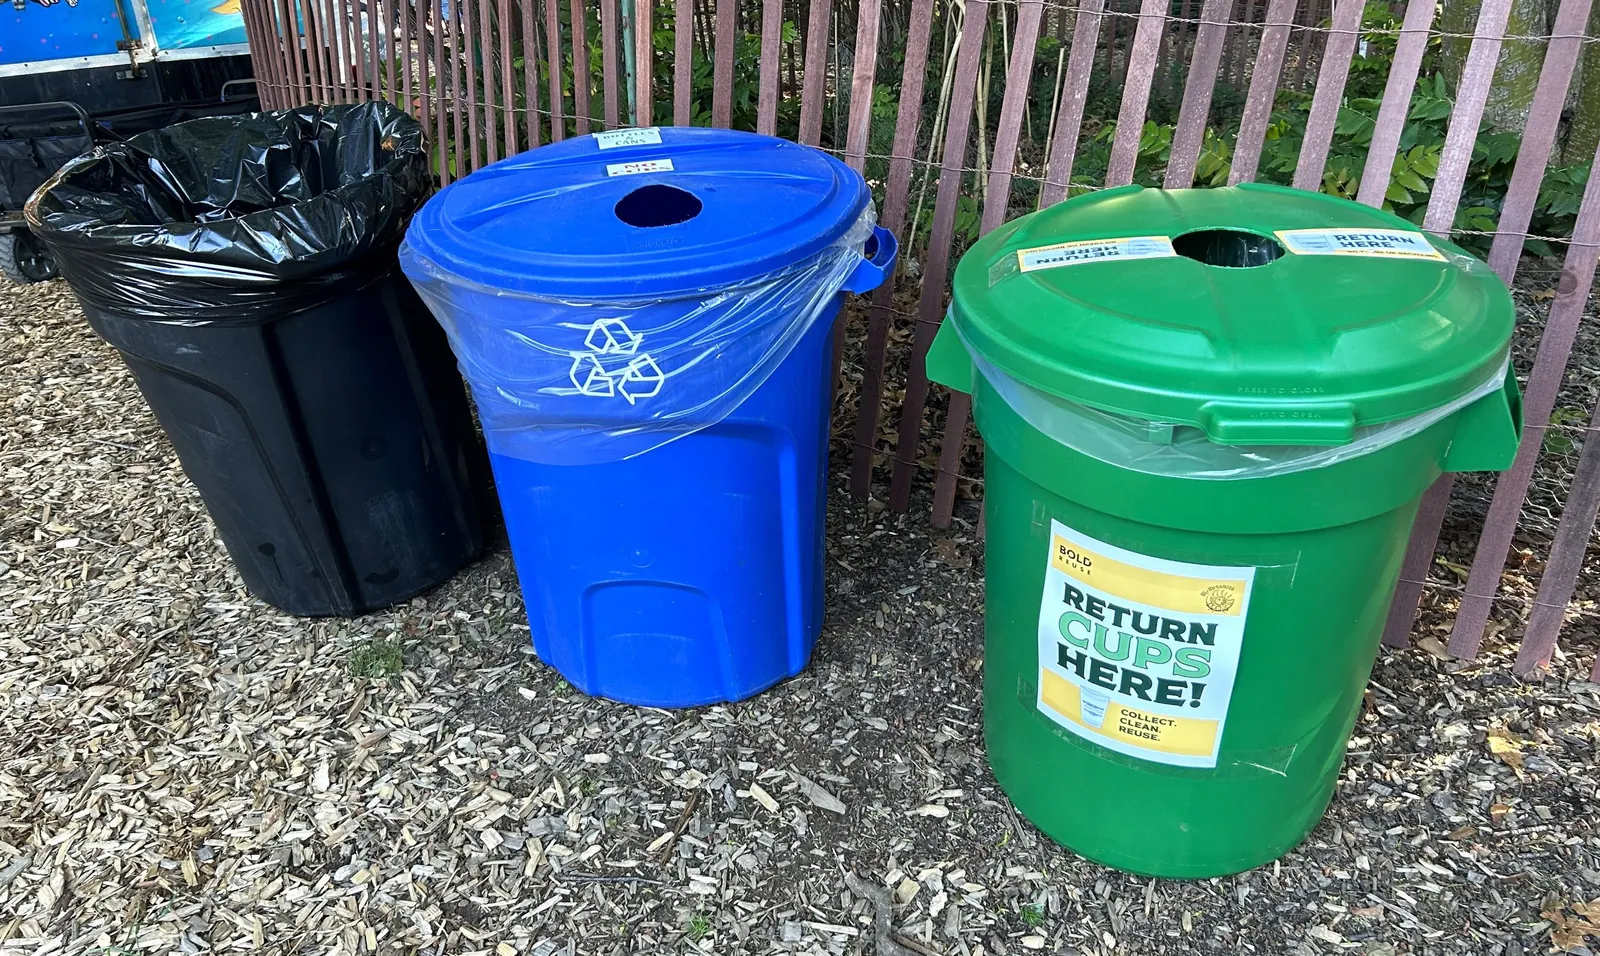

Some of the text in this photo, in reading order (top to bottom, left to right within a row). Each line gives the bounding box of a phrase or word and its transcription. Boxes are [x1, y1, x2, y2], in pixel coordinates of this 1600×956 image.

[1333, 234, 1416, 244] RETURN
[1036, 251, 1119, 264] RETURN
[1063, 246, 1118, 255] HERE
[1291, 386, 1325, 394] CLOSE
[1059, 544, 1092, 567] BOLD
[1058, 555, 1092, 576] REUSE
[1062, 581, 1219, 646] RETURN
[1058, 611, 1212, 679] CUPS
[1056, 642, 1207, 708] HERE!
[1119, 717, 1161, 733] CLEAN.
[1120, 708, 1177, 727] COLLECT.
[1118, 725, 1160, 742] REUSE.
